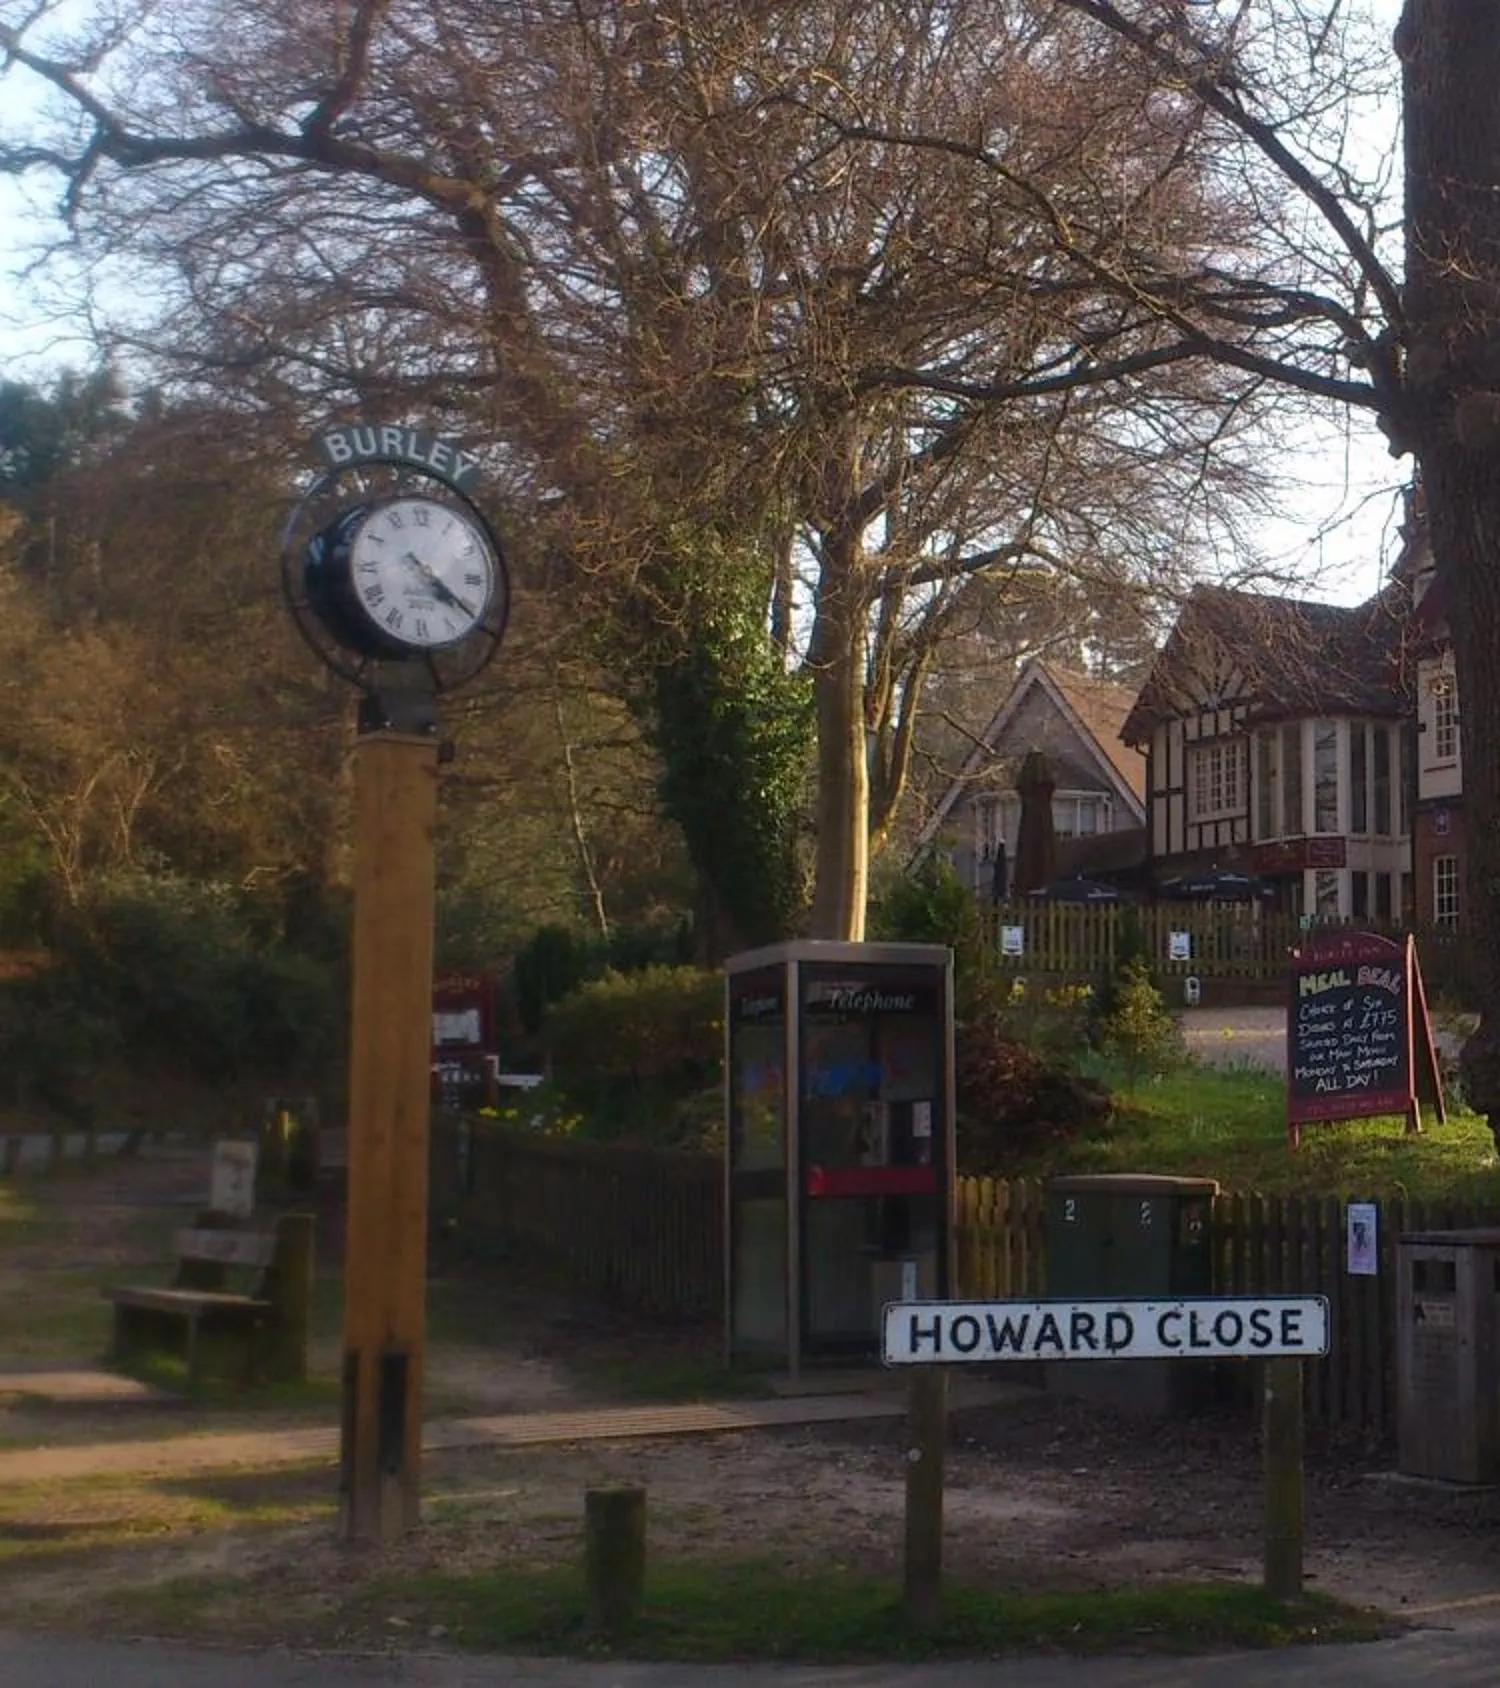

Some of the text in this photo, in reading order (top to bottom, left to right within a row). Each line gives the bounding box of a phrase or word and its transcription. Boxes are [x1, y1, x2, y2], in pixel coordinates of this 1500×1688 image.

[324, 427, 473, 481] BURLEY
[1299, 965, 1401, 997] MEAL DEAL
[829, 989, 916, 1012] Telephone
[1315, 1076, 1342, 1093] ALL
[1064, 1199, 1076, 1222] 2
[909, 1309, 1305, 1353] HOWARD CLOSE
